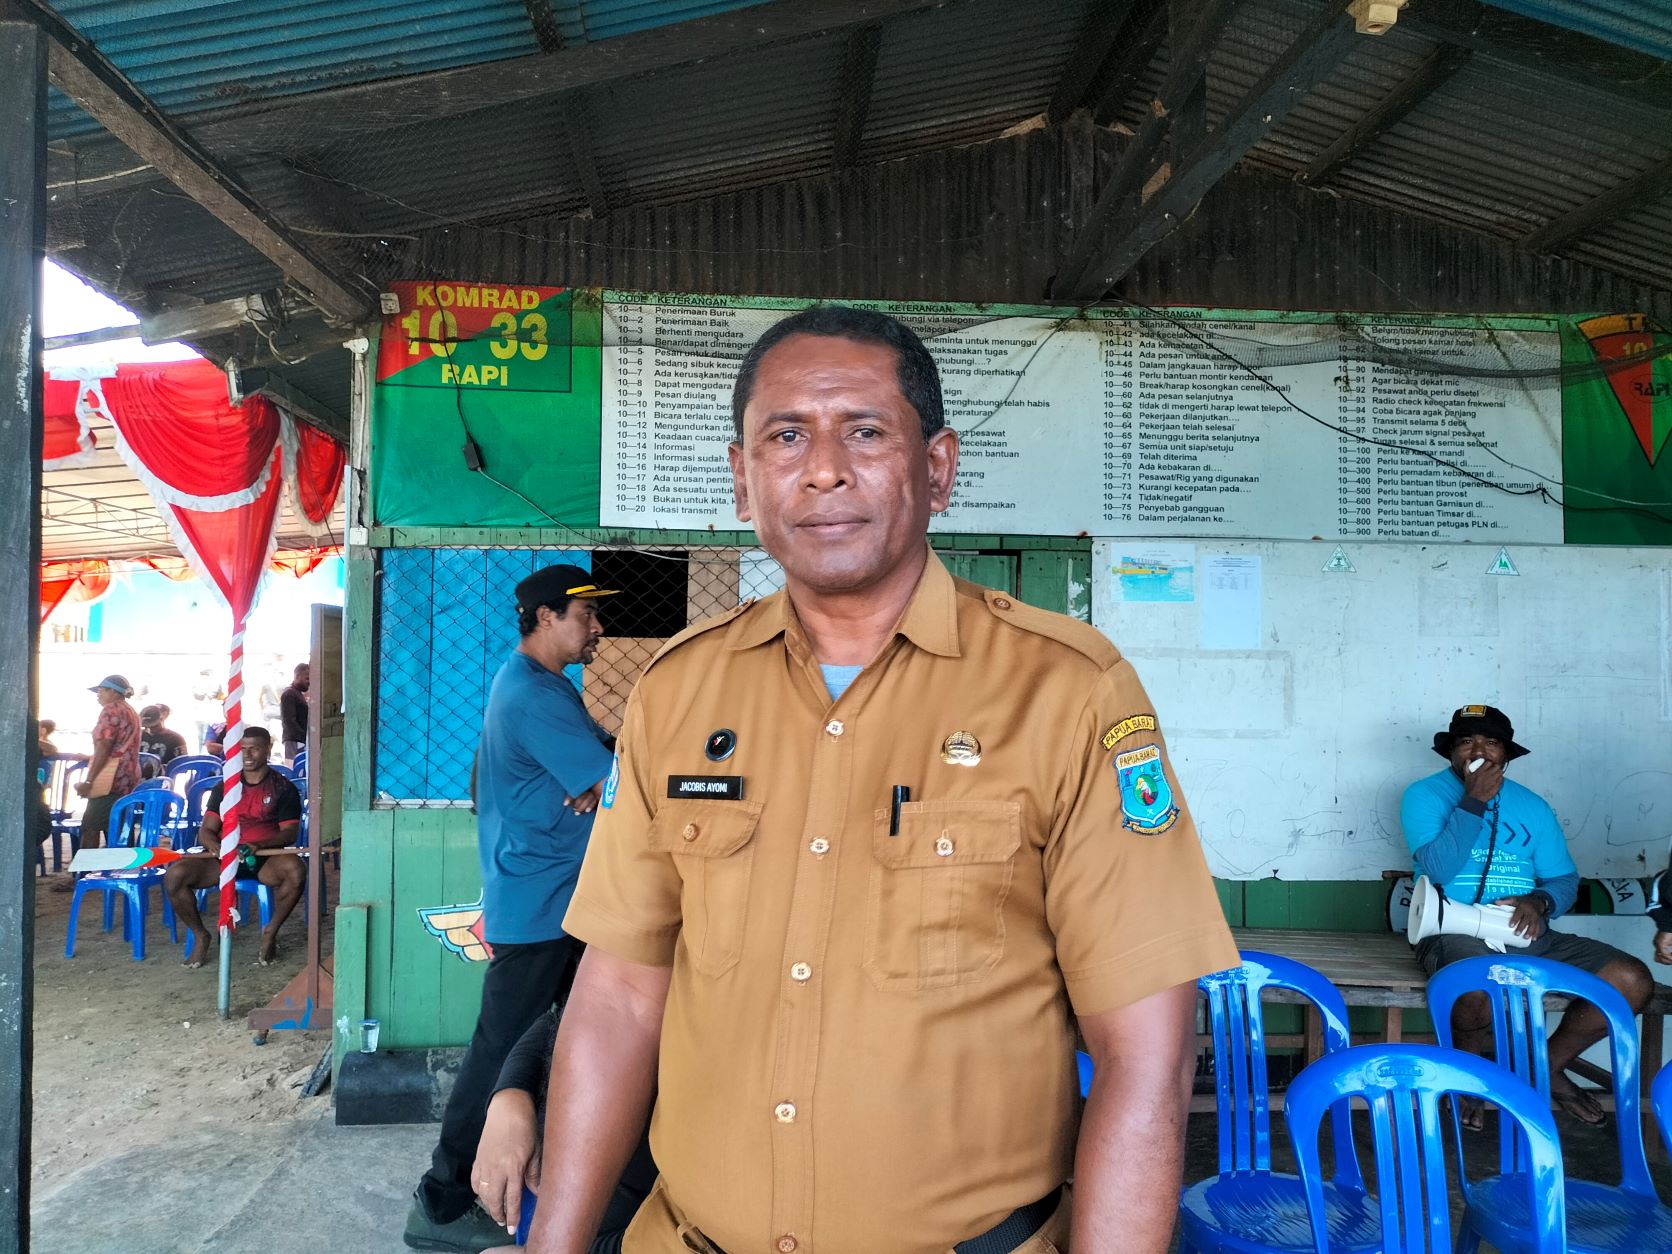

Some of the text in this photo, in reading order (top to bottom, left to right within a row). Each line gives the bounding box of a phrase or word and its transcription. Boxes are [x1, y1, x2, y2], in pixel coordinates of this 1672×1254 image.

[417, 285, 539, 310] KOMRAD
[618, 295, 727, 306] CODE KETERANGAN
[655, 306, 736, 317] Penerimaan Buruk
[888, 304, 953, 312] KETERANGAN
[655, 316, 729, 327] Penerimaan Baik
[1209, 322, 1255, 330] cenel/kanal
[401, 309, 549, 361] 10 33
[655, 327, 743, 340] Berhenti mengudara
[655, 337, 708, 349] Benar/dapat
[992, 339, 1037, 348] menunggu
[985, 348, 1008, 358] tugas
[1158, 353, 1183, 362] pesan
[655, 358, 714, 369] Sedang sibuk
[1168, 362, 1211, 372] jangkauan
[441, 363, 508, 387] RAPI
[654, 369, 672, 377] Ada
[942, 367, 1026, 378] kurang diperhatikan
[1164, 372, 1197, 380] bantuan
[655, 380, 732, 391] Dapat mengudara
[1140, 381, 1190, 392] Break/harap
[1192, 382, 1238, 392] kosongkan
[1372, 376, 1391, 386] Agar
[1420, 378, 1442, 386] dekat
[654, 390, 716, 402] Pesan diulang
[944, 387, 962, 397] sign
[1372, 386, 1406, 394] Pesawat
[1431, 388, 1451, 397] perlu
[1158, 394, 1183, 402] pesan
[1185, 392, 1233, 403] selanjutnya
[1373, 396, 1505, 408] Radio check frekwensi
[654, 401, 713, 412] Penyampaian
[1172, 402, 1208, 412] mengerti
[1211, 403, 1234, 413] harap
[1262, 404, 1291, 414] telepon
[654, 411, 711, 420] Bicara terlalu
[952, 408, 992, 418] peraturan
[1140, 412, 1180, 423] Pekerjaan
[1396, 407, 1420, 415] bicara
[1423, 408, 1442, 418] agak
[1445, 408, 1476, 418] panjang
[655, 421, 720, 433] Mengundurkan
[1139, 422, 1180, 432] Pekerjaan
[654, 432, 692, 440] Keadaan
[971, 429, 1006, 439] pesawat
[1139, 432, 1183, 442] Menunggu
[1212, 434, 1260, 444] selanjutnya
[1400, 428, 1422, 438] jarum
[1425, 429, 1449, 439] signal
[654, 442, 695, 451] Informasi
[960, 439, 1007, 447] kecelakaan
[1399, 438, 1427, 446] selesai
[985, 449, 1019, 458] bantuan
[1188, 443, 1234, 453] siap/setuju
[654, 453, 724, 463] Informasi sudah
[1400, 458, 1433, 466] bantuan
[654, 463, 679, 474] Harap
[1158, 463, 1200, 471] kebakaran
[653, 474, 670, 482] Ada
[1139, 473, 1190, 483] Pesawat/Rig
[1193, 476, 1213, 484] yang
[1216, 474, 1260, 484] digunakan
[1400, 468, 1440, 479] pemadam
[673, 485, 707, 493] sesuatu
[1139, 483, 1217, 494] Kurangi kecepatan
[1400, 488, 1433, 496] bantuan
[1436, 489, 1467, 499] provost
[654, 494, 708, 504] Bukan untuk
[1140, 493, 1193, 503] Tidak/negatif
[681, 506, 717, 514] transmit
[962, 500, 1016, 511] disampaikan
[1139, 503, 1224, 514] Penyebab gangguan
[1400, 509, 1433, 517] bantuan
[1436, 510, 1464, 518] Timsar
[1167, 514, 1211, 525] perjalanan
[1400, 519, 1433, 527] bantuan
[1437, 520, 1469, 530] petugas
[1105, 716, 1153, 746] PAPUA BARAT
[1119, 753, 1140, 767] PAPUA
[680, 782, 728, 792] JACOBIS AYOMI
